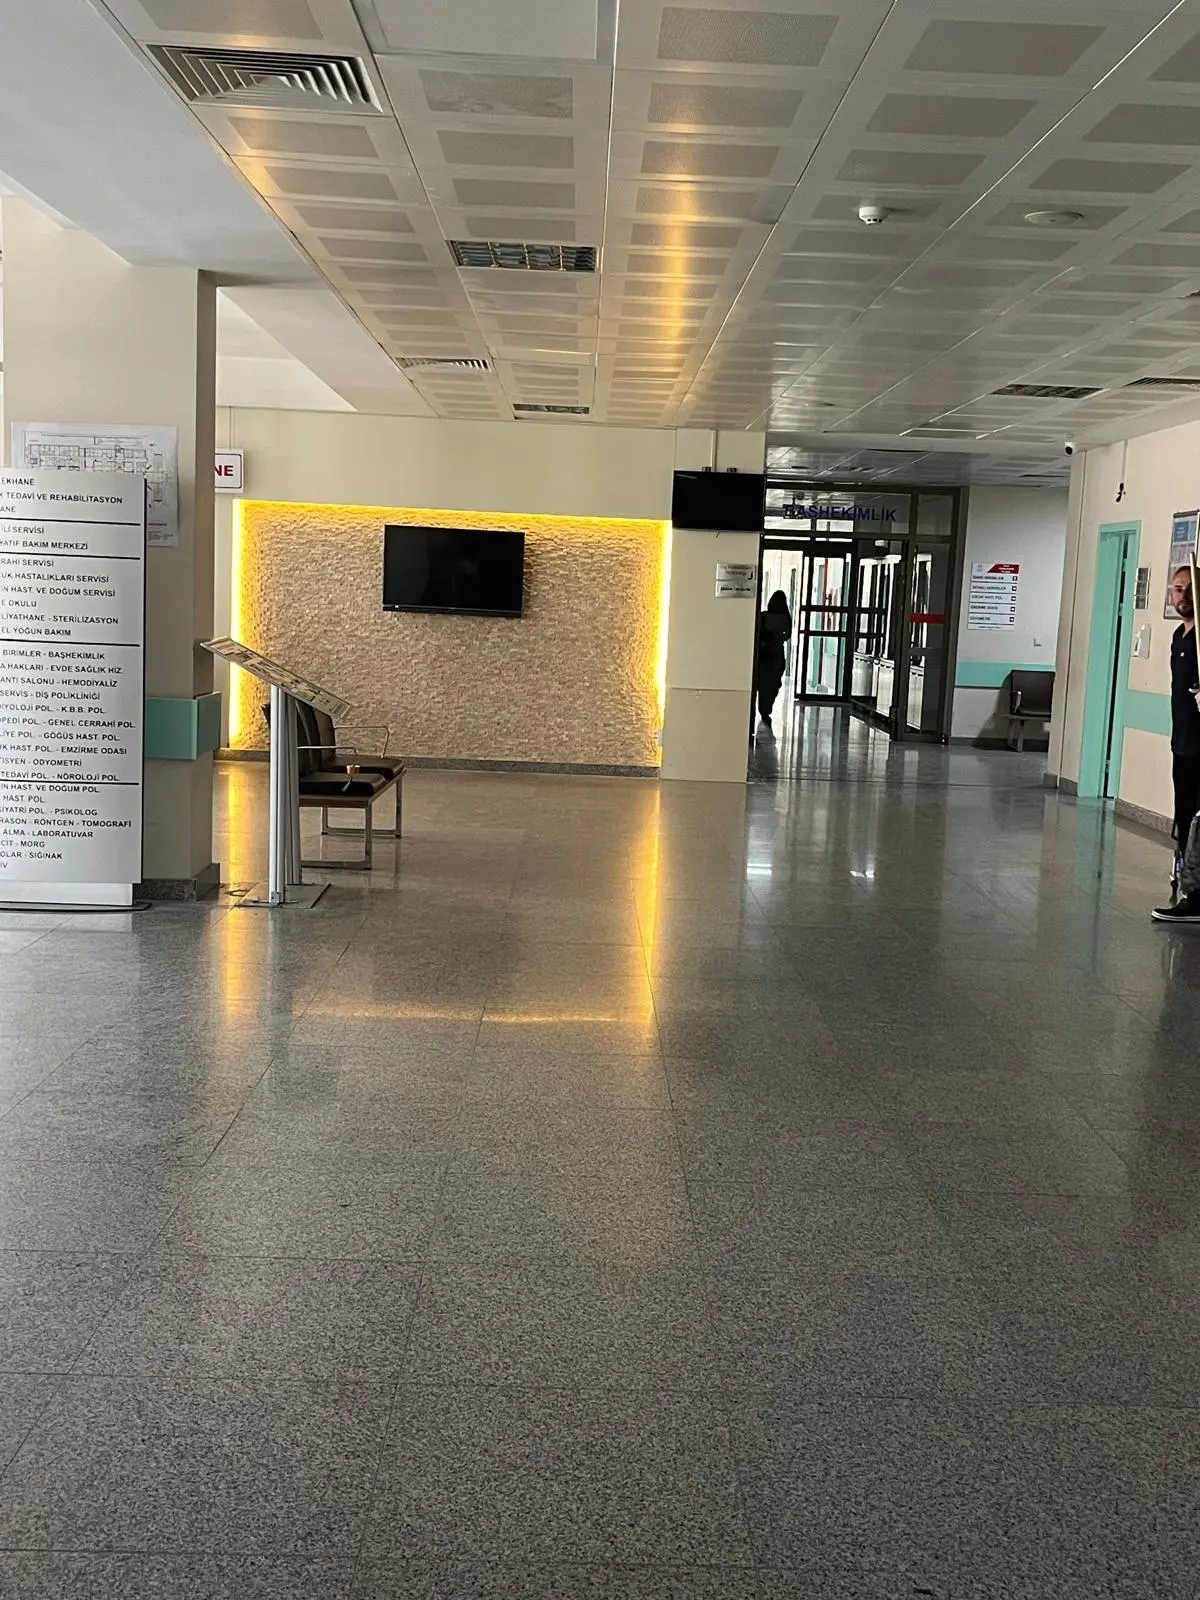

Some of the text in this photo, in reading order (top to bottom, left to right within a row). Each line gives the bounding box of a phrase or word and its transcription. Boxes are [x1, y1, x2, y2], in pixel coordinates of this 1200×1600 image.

[37, 493, 48, 501] VE
[15, 573, 74, 582] HASTALIKLARI
[50, 587, 80, 595] DOĞUM
[13, 627, 42, 635] YOĞUN
[75, 665, 106, 673] SAĞLIK
[20, 677, 54, 685] SALONU
[61, 746, 98, 754] EMZİRME
[33, 759, 81, 767] ODYOMETRİ
[82, 820, 131, 828] TOMOGRAFİ
[32, 830, 93, 838] LABORATUVAR
[20, 840, 45, 848] MORG
[30, 851, 62, 859] SIĞINAK
